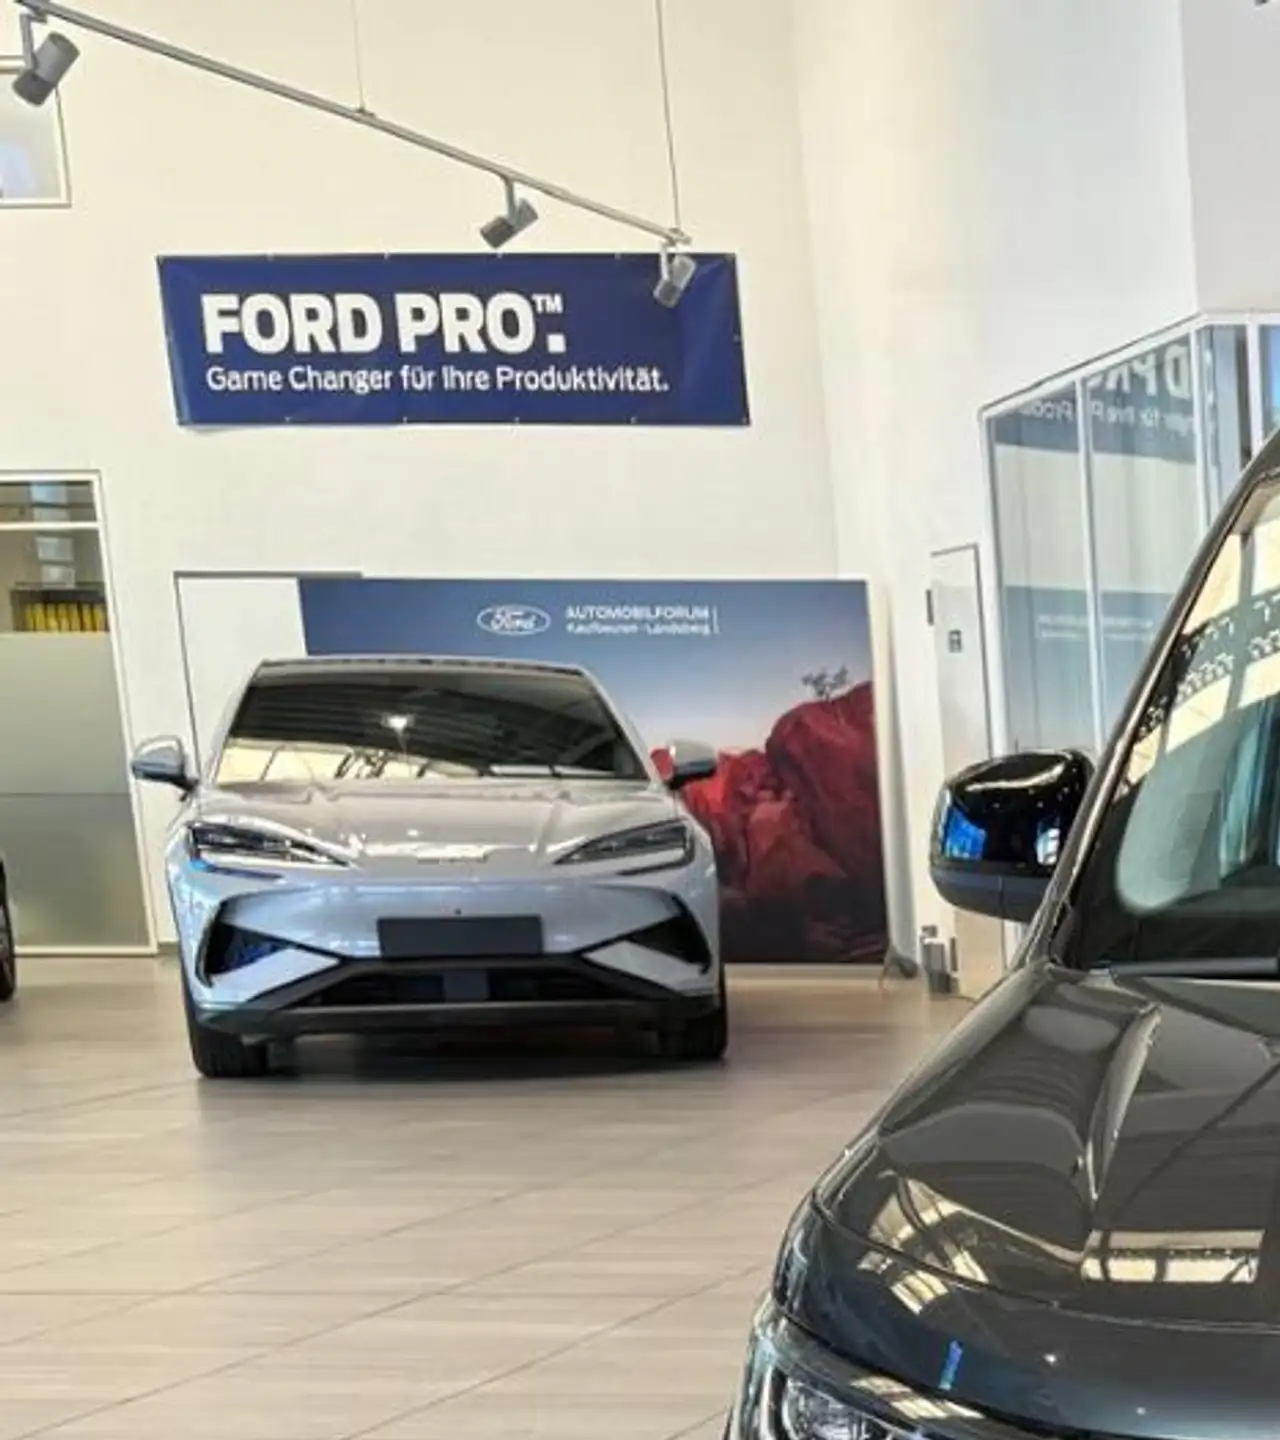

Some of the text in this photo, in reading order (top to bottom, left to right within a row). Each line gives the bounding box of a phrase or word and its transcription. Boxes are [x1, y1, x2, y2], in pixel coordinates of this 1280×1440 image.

[202, 292, 383, 354] FORD
[206, 364, 669, 395] Game Changer für Ihre Produktivität.
